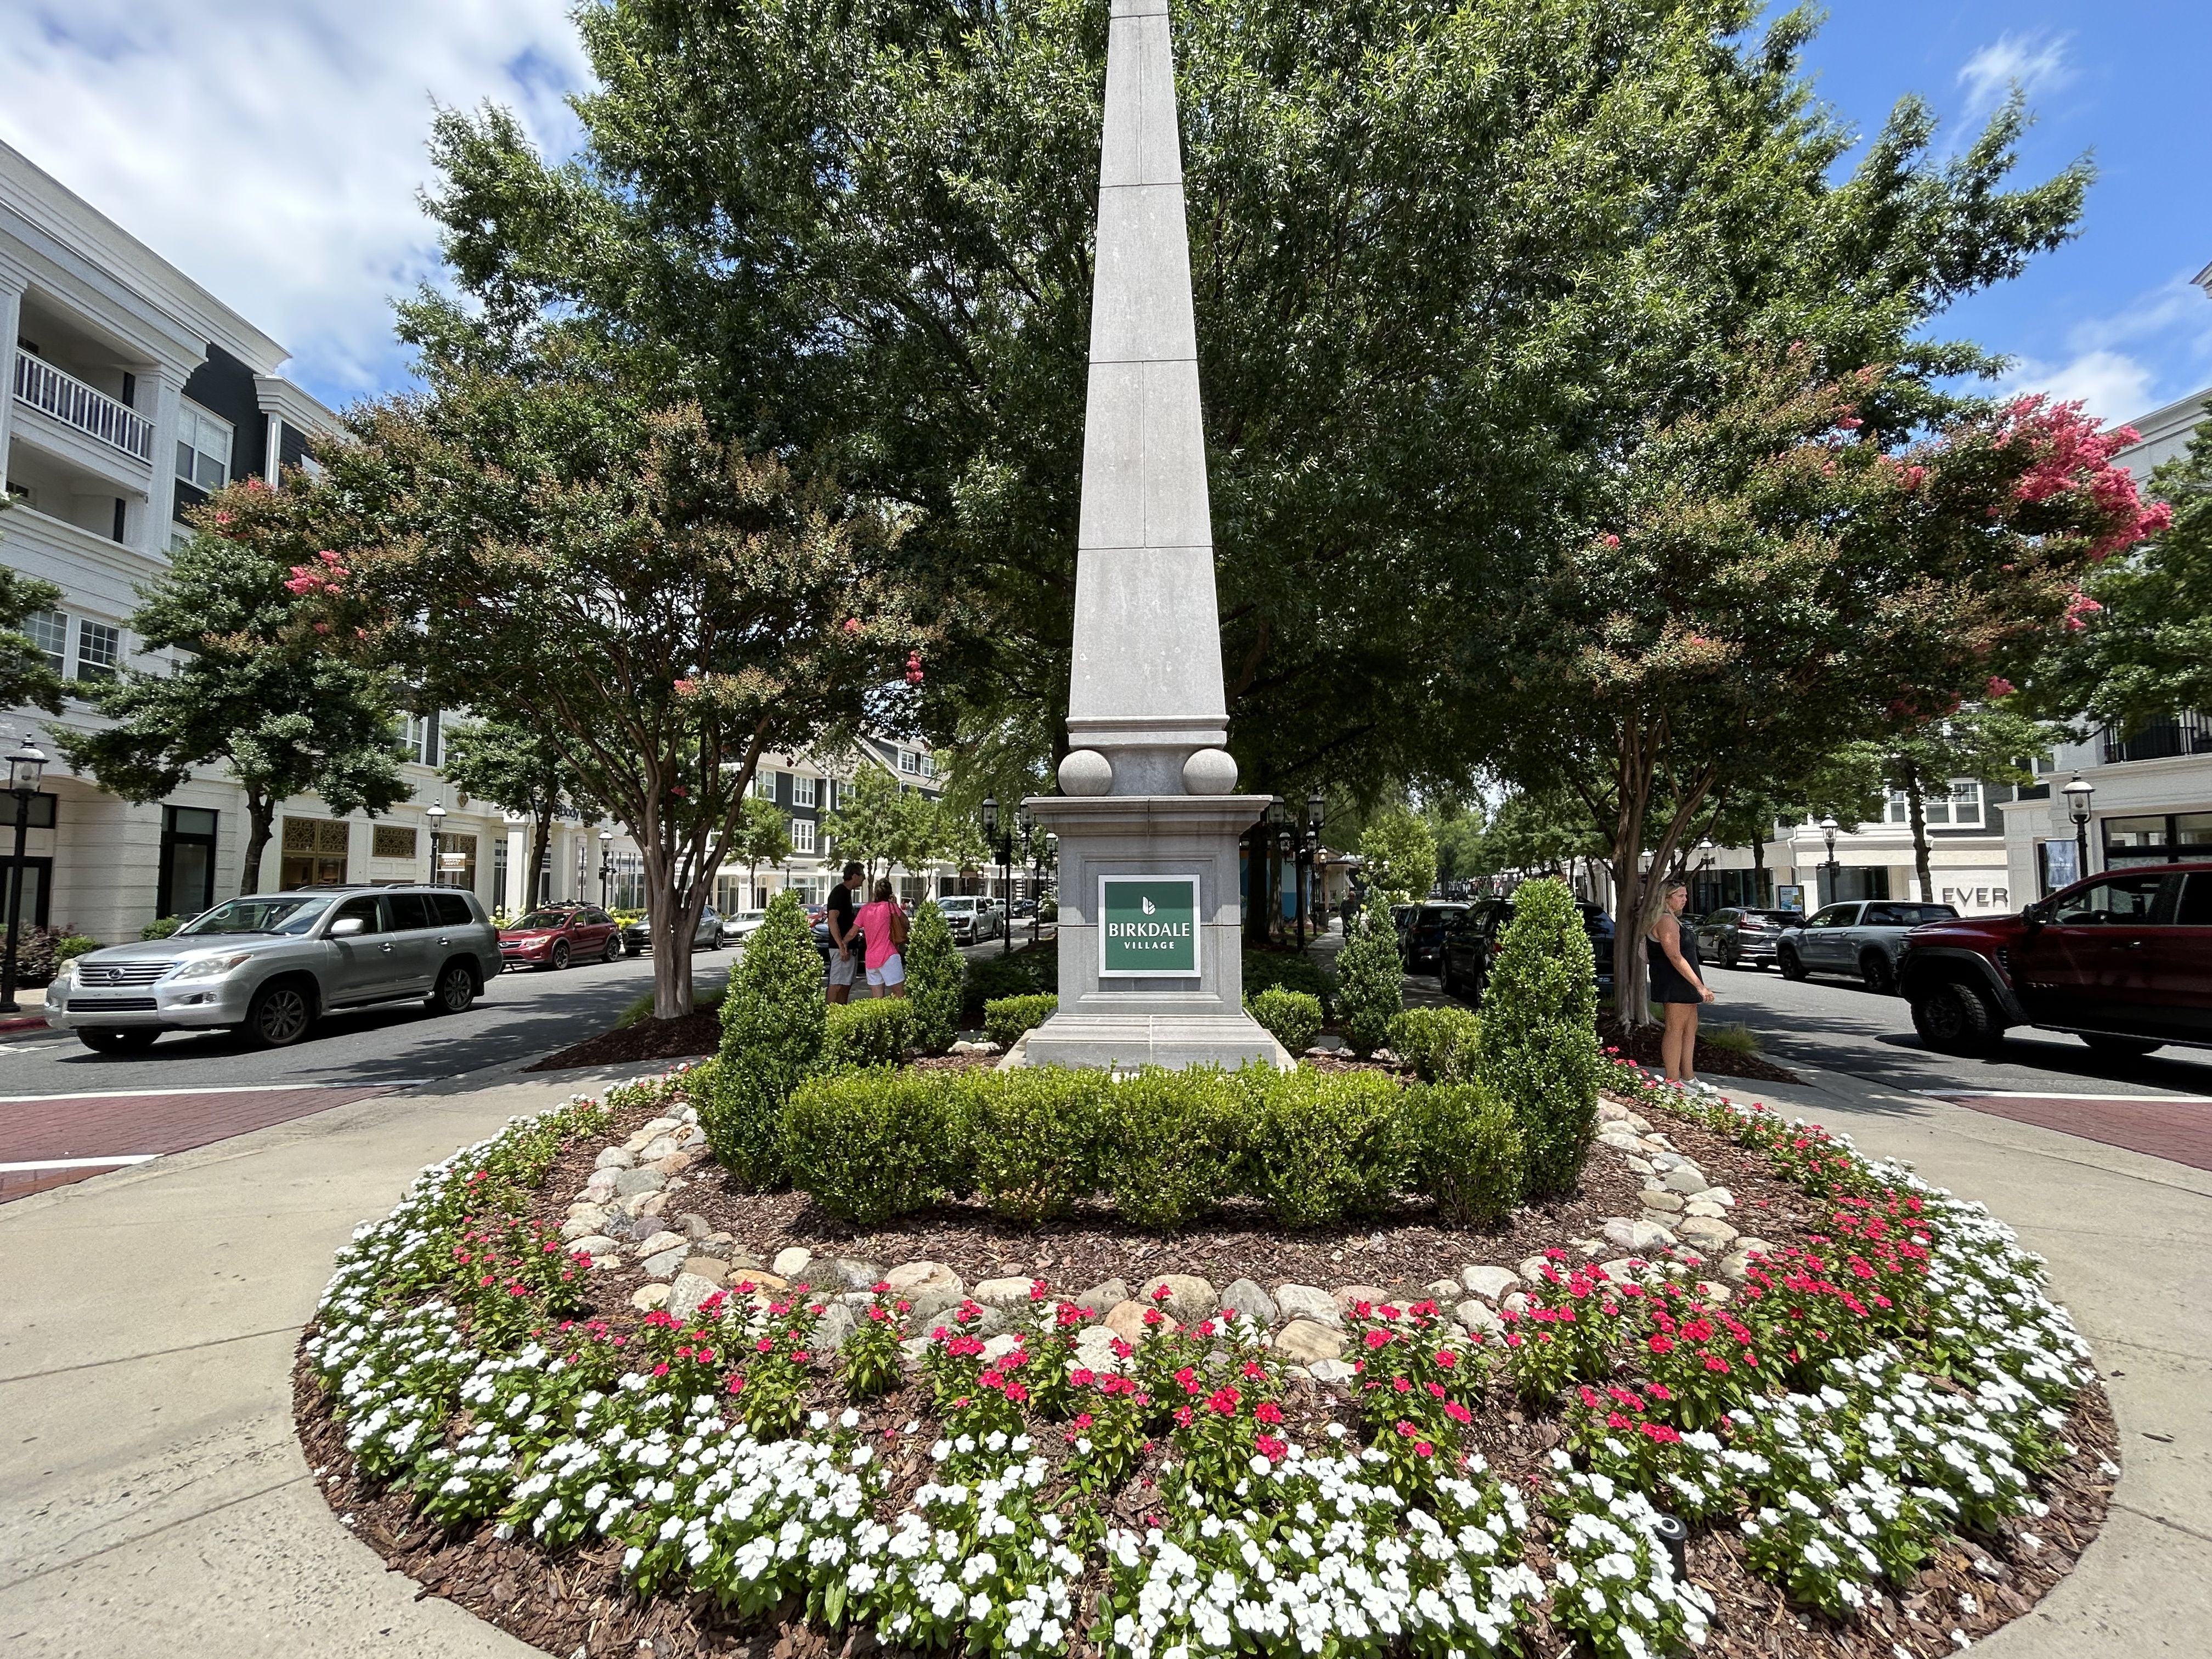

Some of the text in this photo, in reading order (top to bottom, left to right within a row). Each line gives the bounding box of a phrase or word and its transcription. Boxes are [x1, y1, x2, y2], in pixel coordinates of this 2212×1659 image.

[560, 804, 579, 821] Body
[1942, 888, 2008, 907] EVER
[1109, 923, 1190, 937] BIRKDALE
[1124, 941, 1175, 950] VILLAGE
